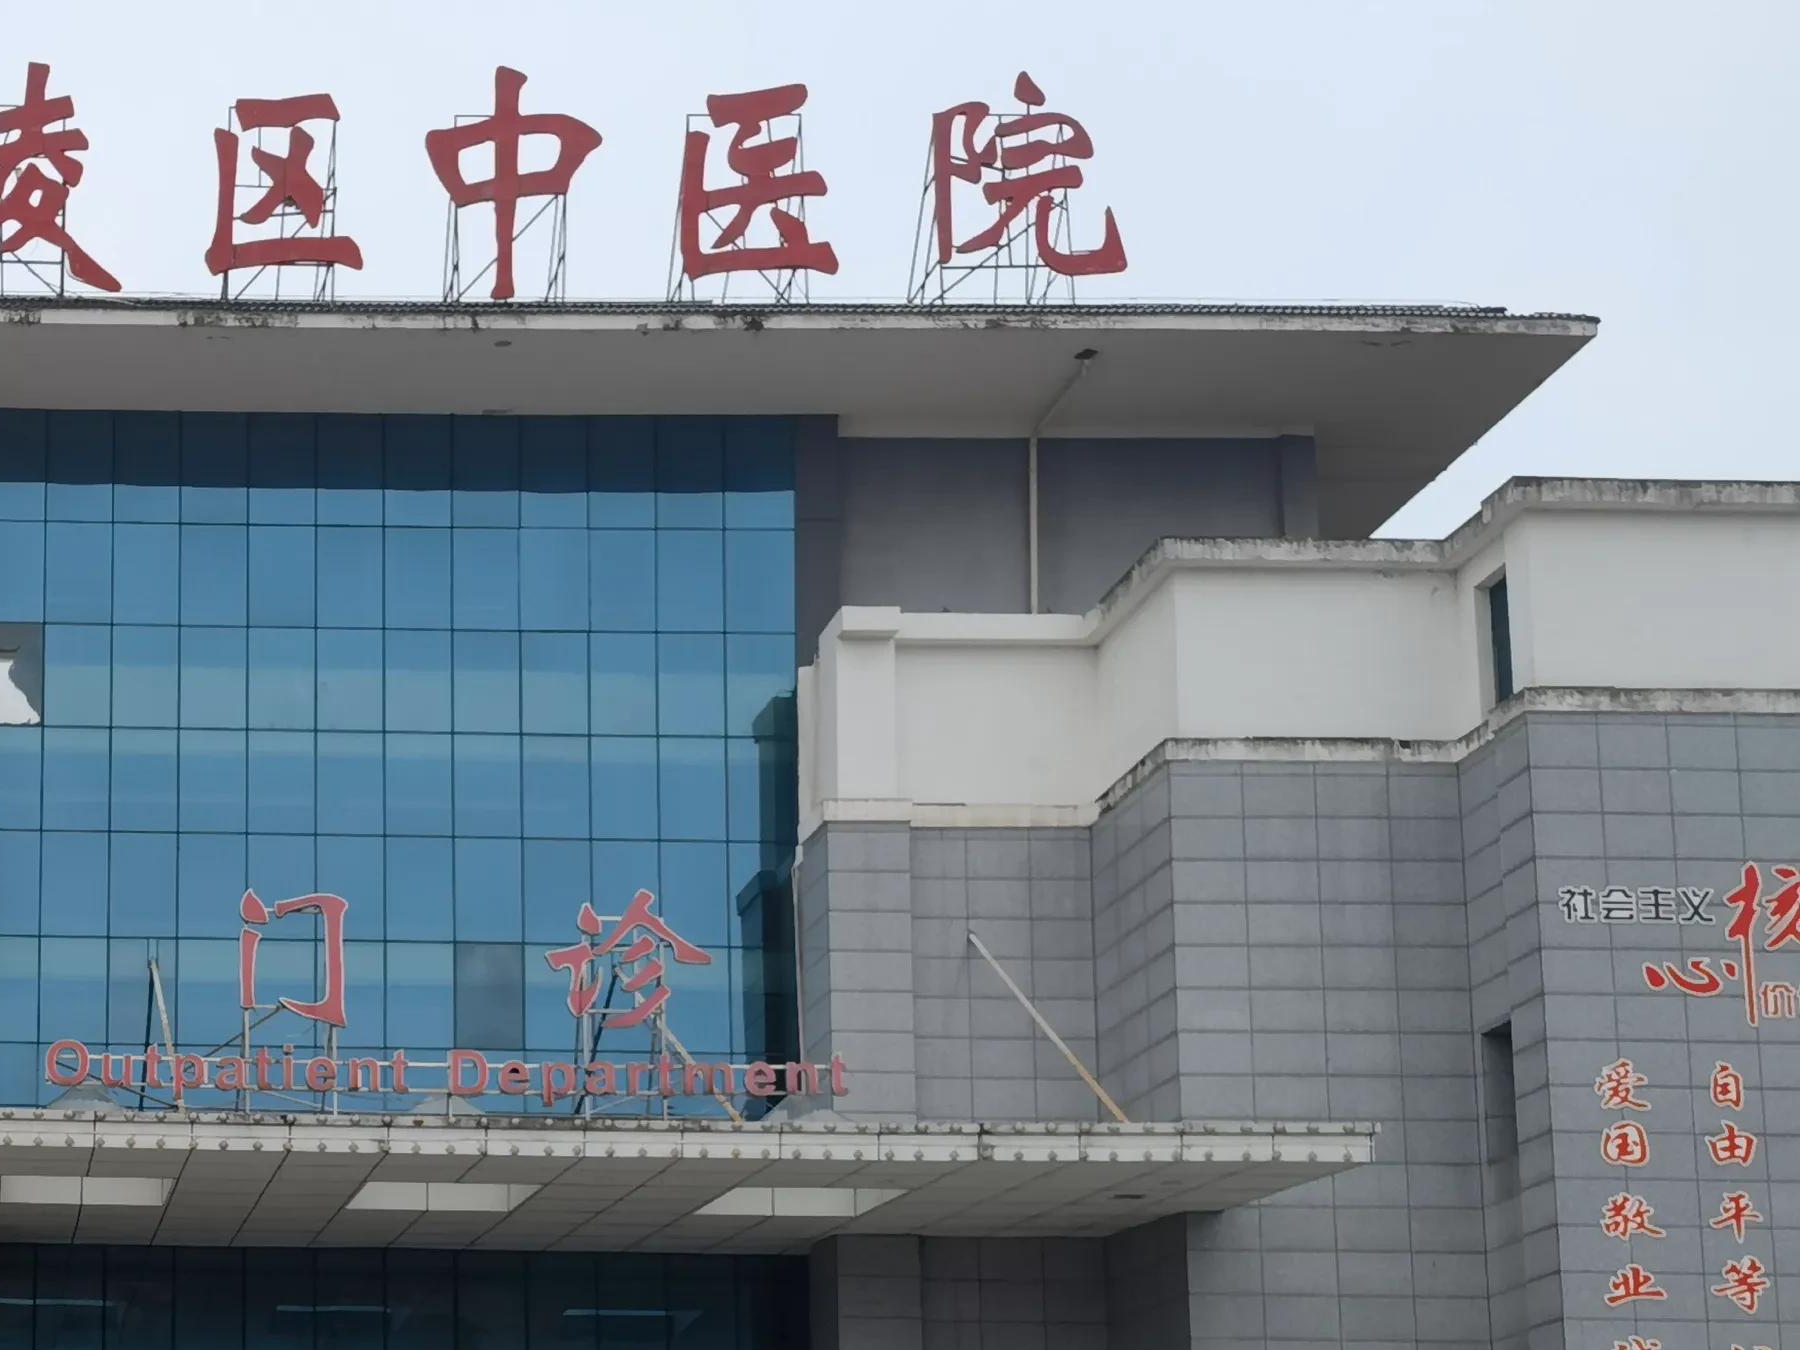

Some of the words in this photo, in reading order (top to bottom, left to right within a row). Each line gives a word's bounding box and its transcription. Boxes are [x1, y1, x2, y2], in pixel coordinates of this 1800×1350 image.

[1558, 886, 1714, 924] 社会主义
[238, 887, 712, 1028] 门诊
[45, 1039, 409, 1099] Outpatient
[449, 1048, 850, 1107] Department
